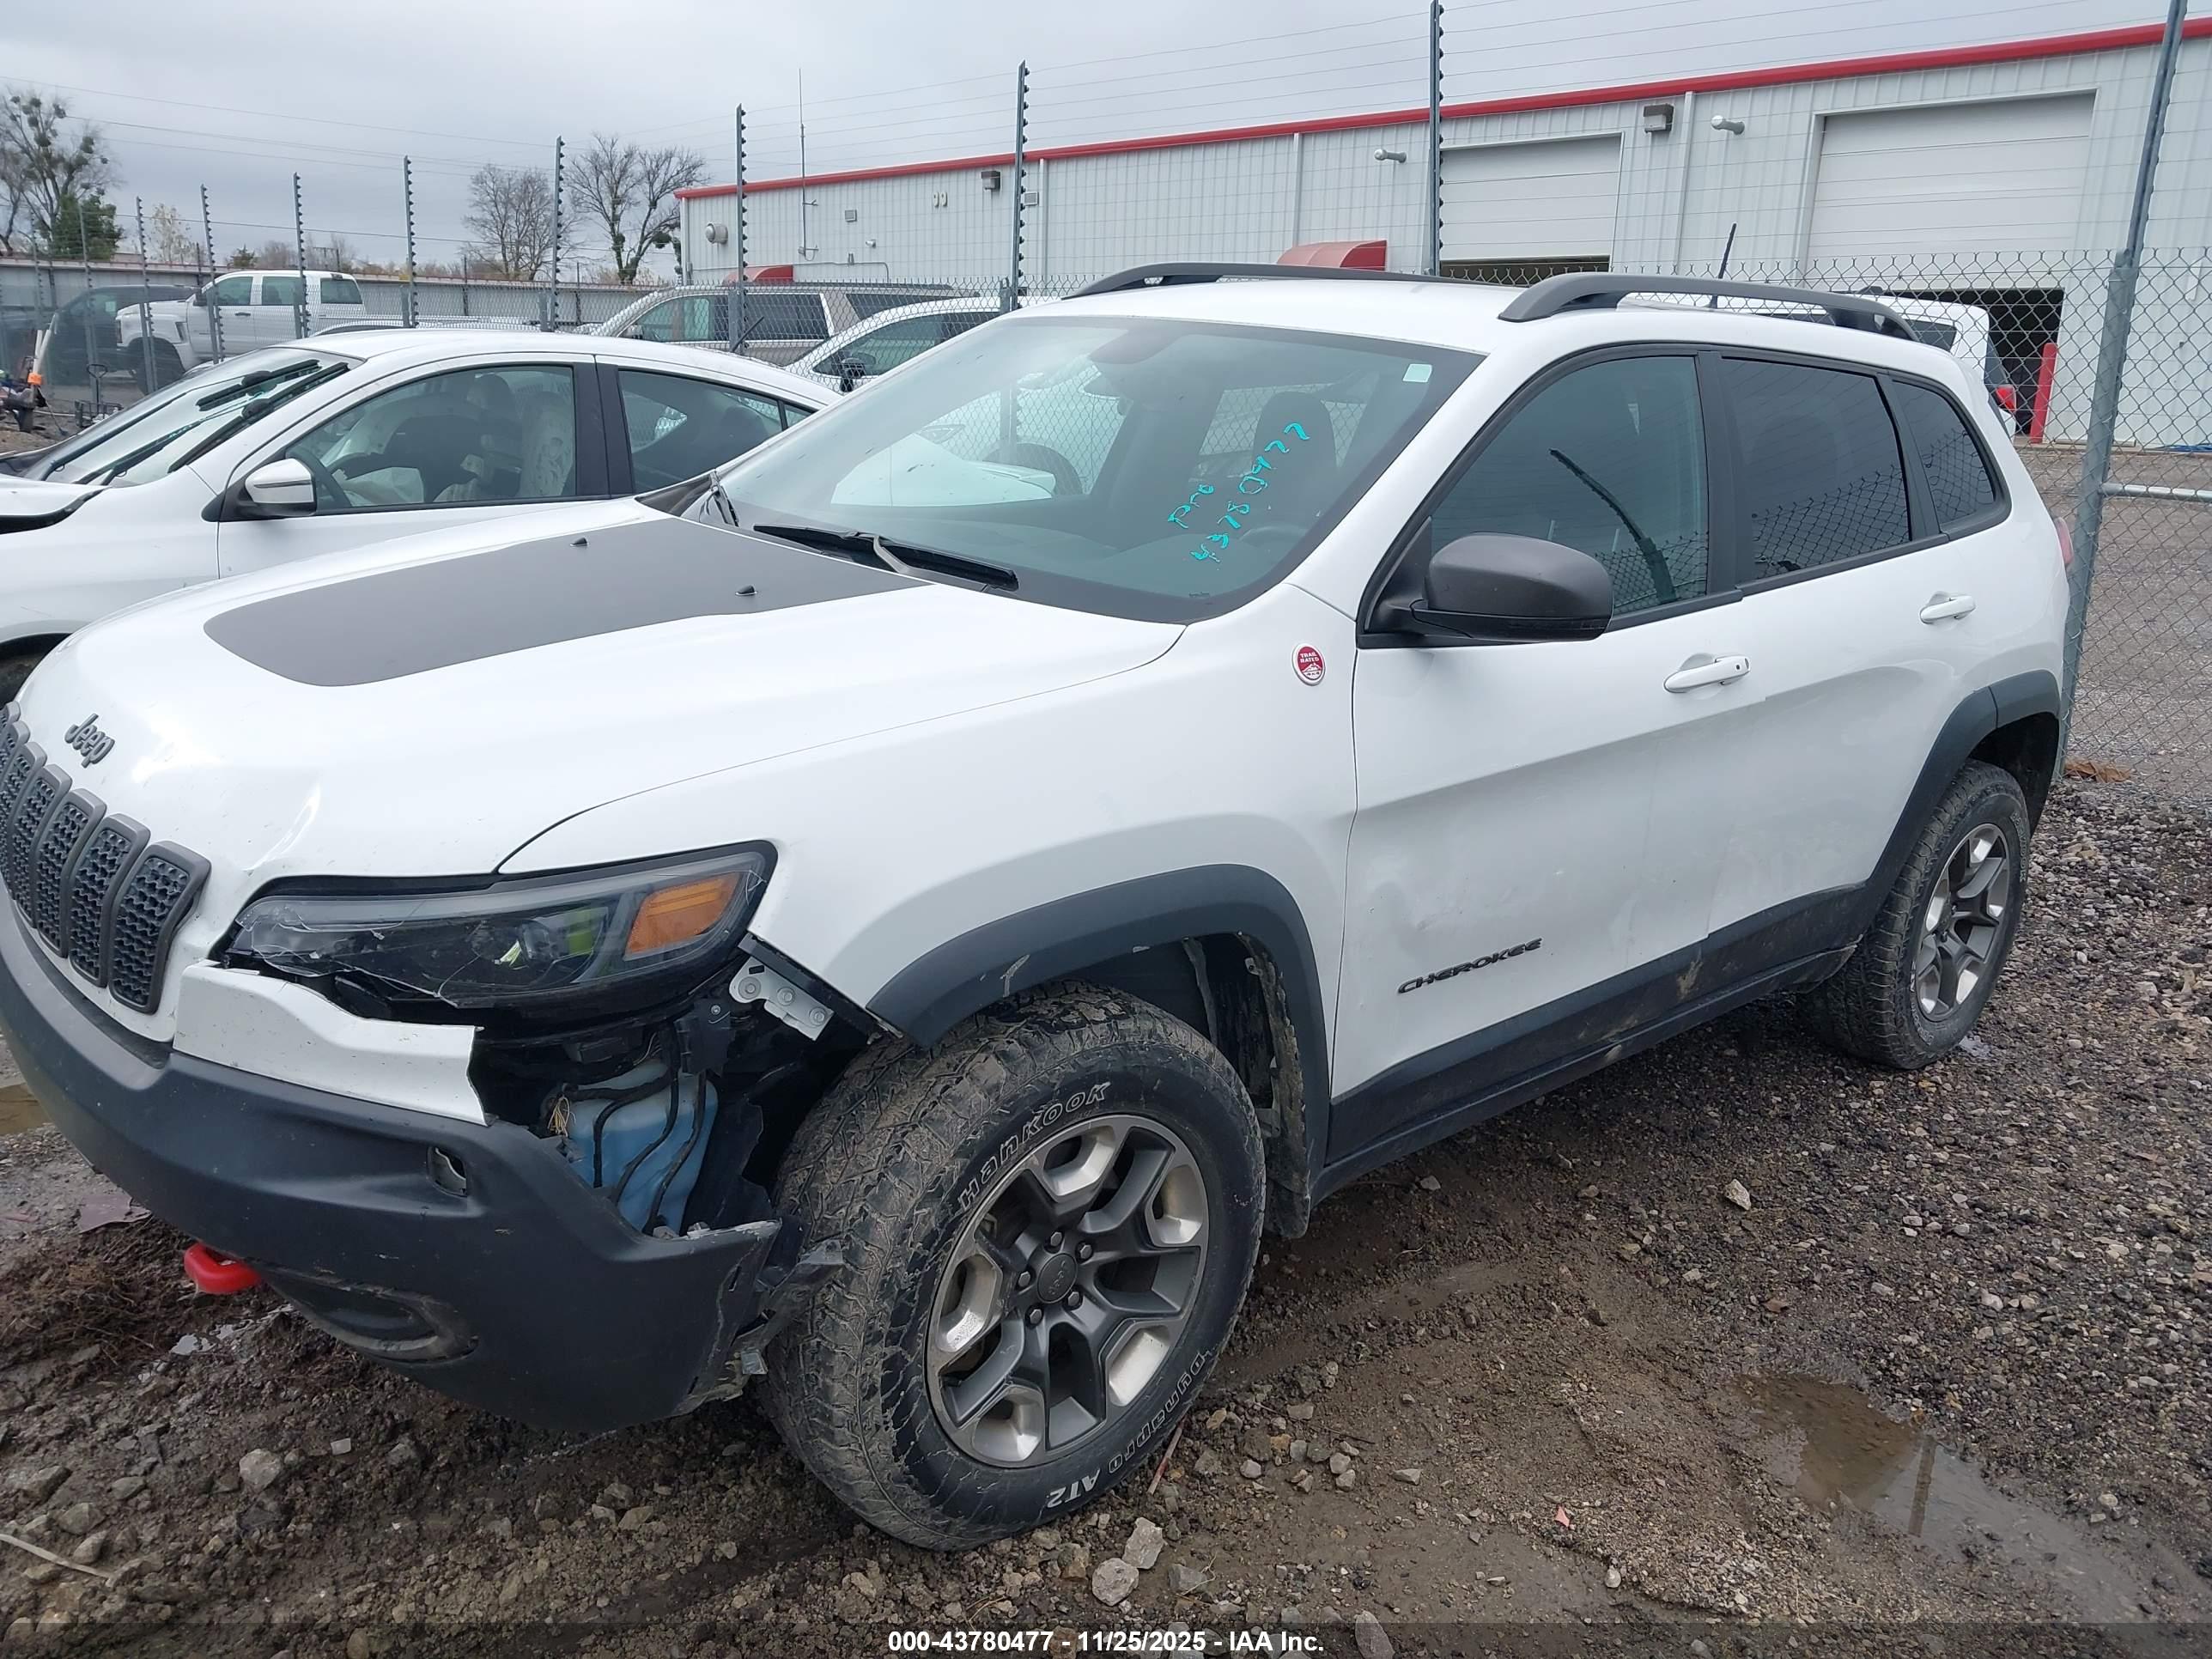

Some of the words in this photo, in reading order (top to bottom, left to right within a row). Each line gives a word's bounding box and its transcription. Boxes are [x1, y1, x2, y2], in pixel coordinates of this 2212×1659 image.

[1299, 651, 1318, 659] TRAIL
[64, 713, 116, 769] Jeep
[1396, 938, 1543, 994] CHEROKEE
[1046, 1467, 1101, 1509] AT2
